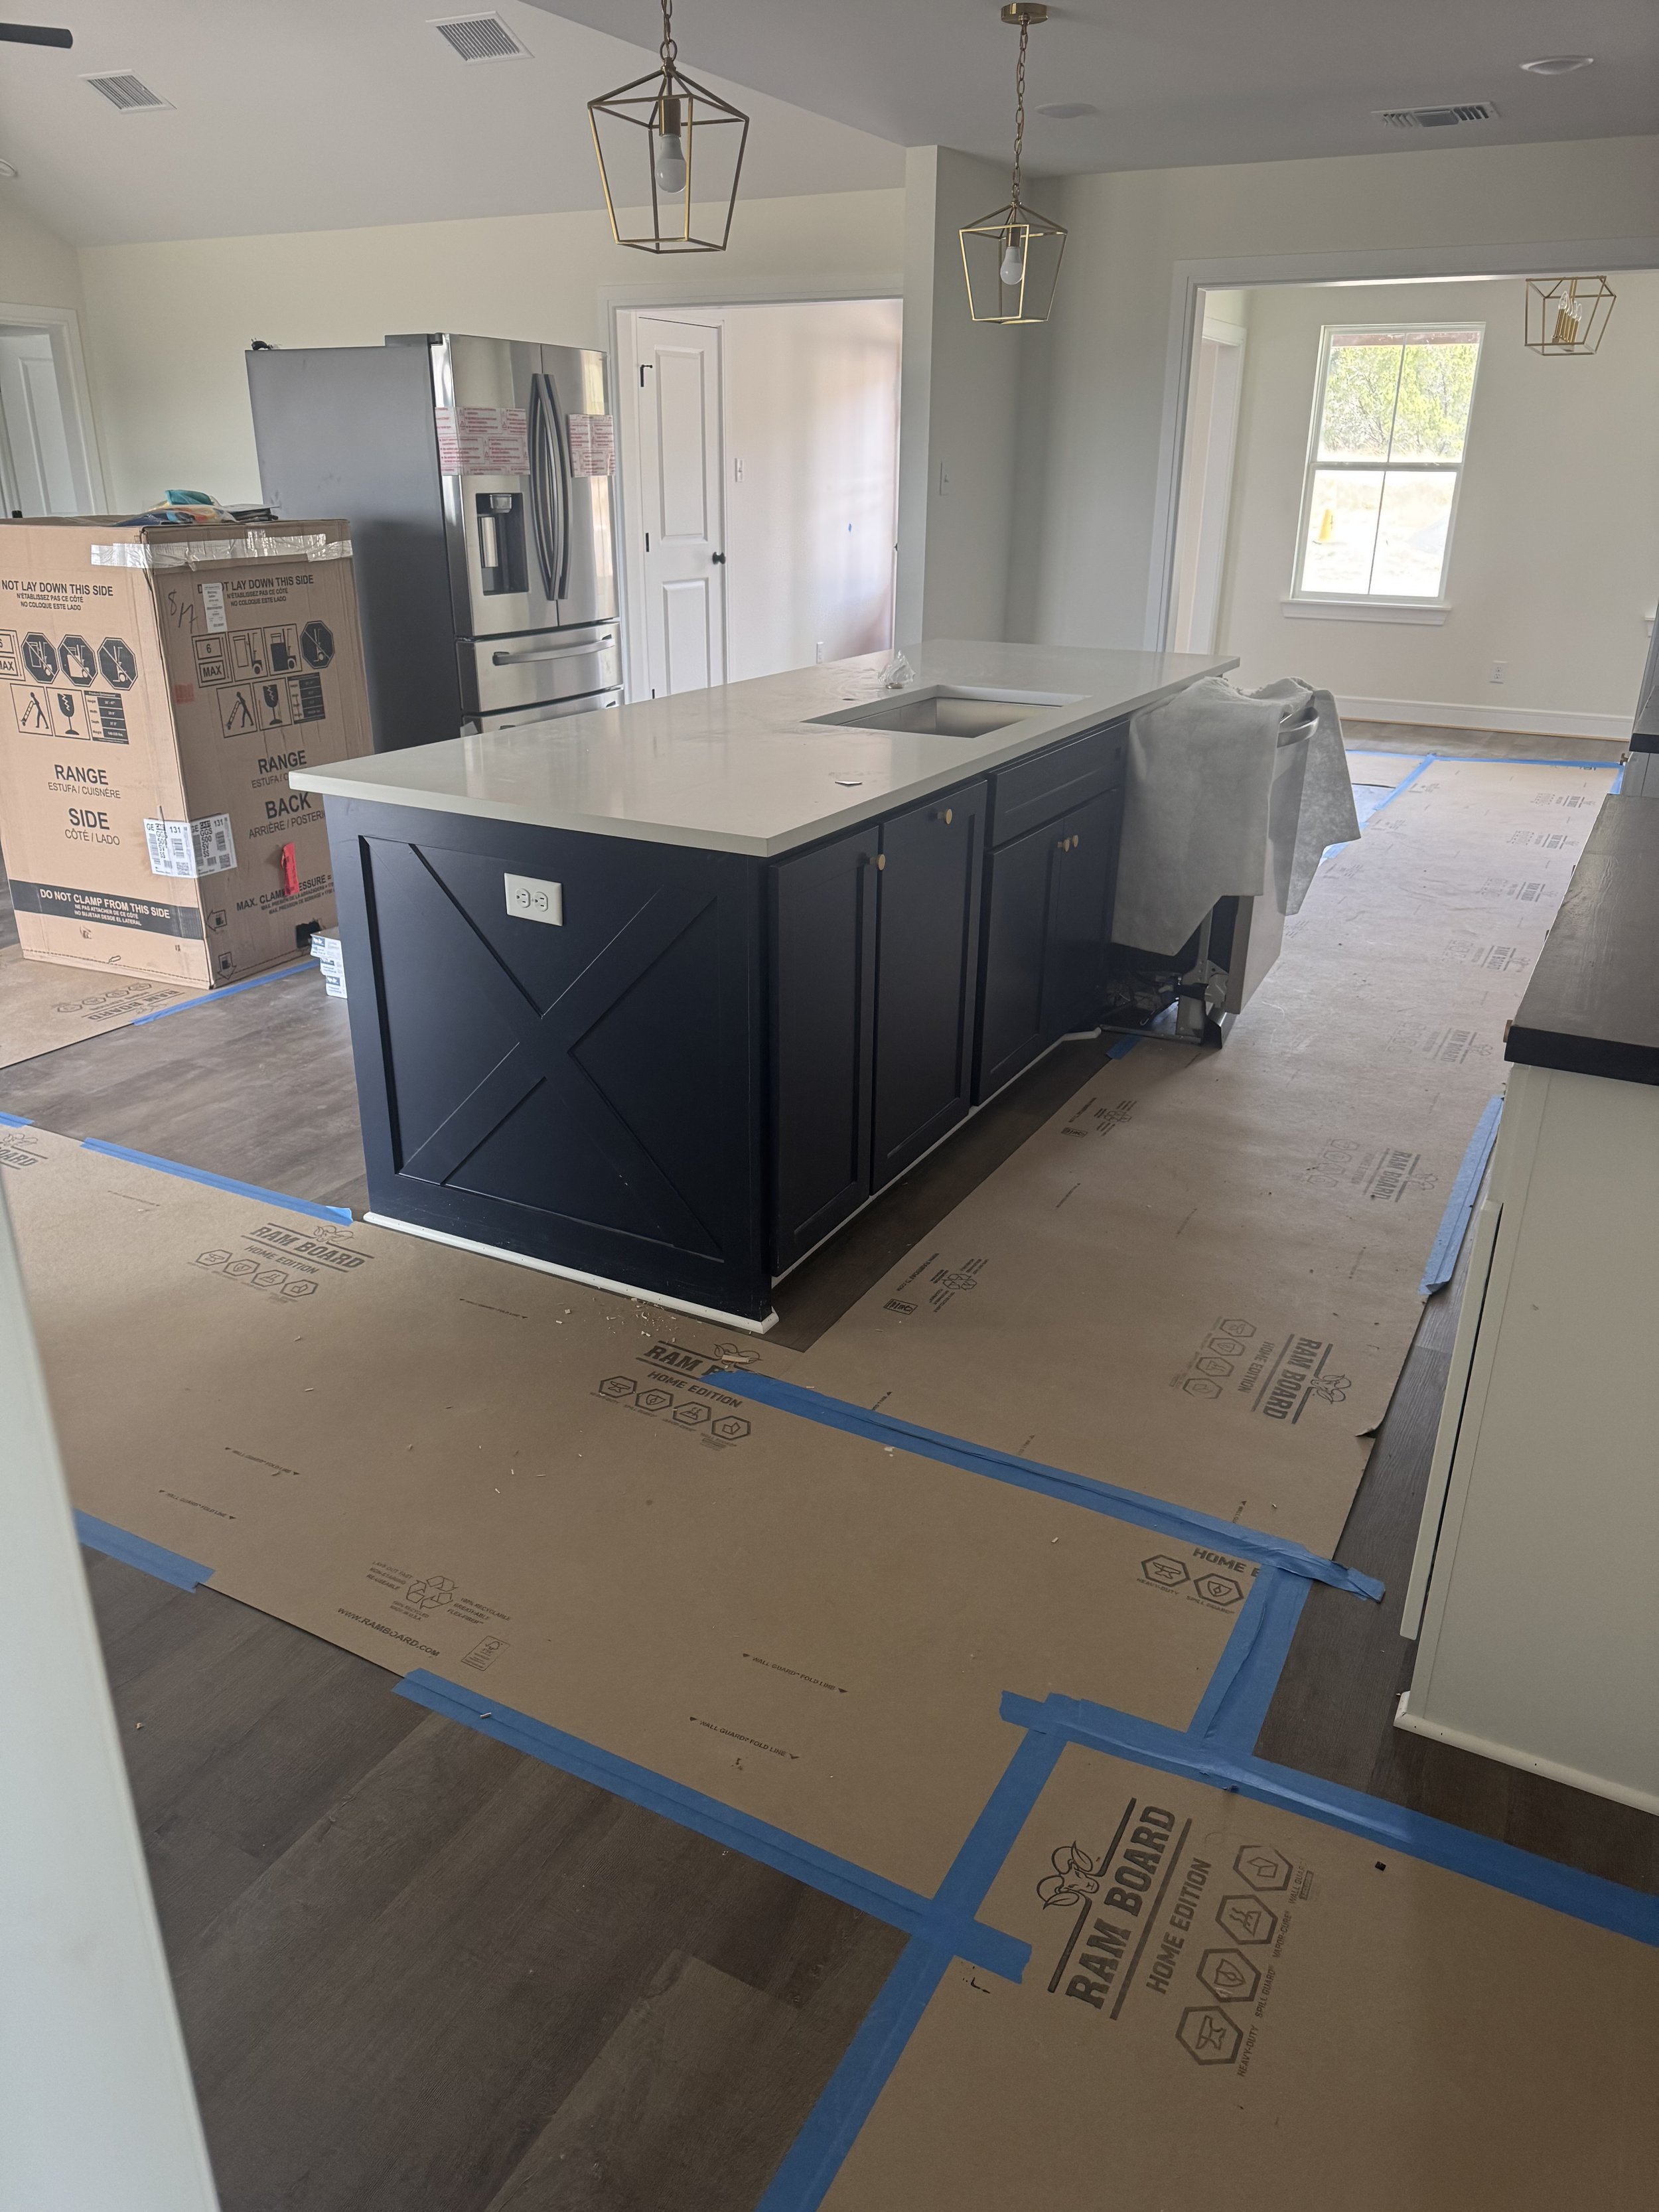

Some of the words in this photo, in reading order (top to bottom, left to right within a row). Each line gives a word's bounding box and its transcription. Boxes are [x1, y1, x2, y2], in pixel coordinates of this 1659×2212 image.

[1, 579, 19, 591] NOT
[21, 581, 37, 592] LAY
[39, 582, 67, 594] DOWN
[69, 584, 90, 595] THIS
[92, 585, 113, 597] SIDE
[231, 580, 246, 591] LAY
[248, 577, 274, 589] DOWN
[275, 575, 294, 587] THIS
[295, 575, 314, 585] SIDE
[206, 643, 212, 654] 6
[202, 665, 222, 678] MAX
[257, 750, 307, 774] RANGE
[54, 764, 109, 785] RANGE
[252, 775, 279, 788] ESTUFA
[48, 782, 77, 794] ESTUFA
[265, 792, 311, 819] BACK
[68, 808, 110, 830] SIDE
[214, 818, 224, 827] 131
[96, 833, 120, 846] LADO
[39, 888, 52, 899] DO
[54, 891, 71, 902] NOT
[73, 894, 102, 907] CLAMP
[104, 899, 128, 911] FROM
[130, 903, 150, 915] THIS
[151, 907, 171, 919] SIDE
[1386, 1150, 1413, 1171] RAM
[250, 1226, 300, 1247] RAM
[294, 1241, 366, 1268] BOARD
[244, 1245, 275, 1260] HOME
[276, 1256, 320, 1274] EDITION
[643, 1345, 703, 1372] RAM
[1254, 1341, 1275, 1363] HOME
[1287, 1337, 1322, 1370] RAM
[647, 1370, 688, 1389] HOME
[687, 1384, 743, 1408] EDITION
[1238, 1362, 1263, 1393] EDITION
[1263, 1369, 1307, 1420] BOARD
[1192, 1547, 1246, 1574] HOME
[800, 1674, 819, 1684] FOLD
[820, 1681, 835, 1690] LINE
[699, 1720, 718, 1731] WALL
[749, 1739, 768, 1750] FOLD
[769, 1747, 786, 1757] LINE
[1288, 1886, 1301, 1904] WALL
[1064, 1917, 1131, 2010] RAM
[1104, 1805, 1176, 1917] BOARD
[1145, 1931, 1185, 1995] HOME
[1169, 1857, 1213, 1932] EDITION
[1255, 1996, 1268, 2018] SPILL
[1237, 2024, 1260, 2077] HEAVY-DUTY
